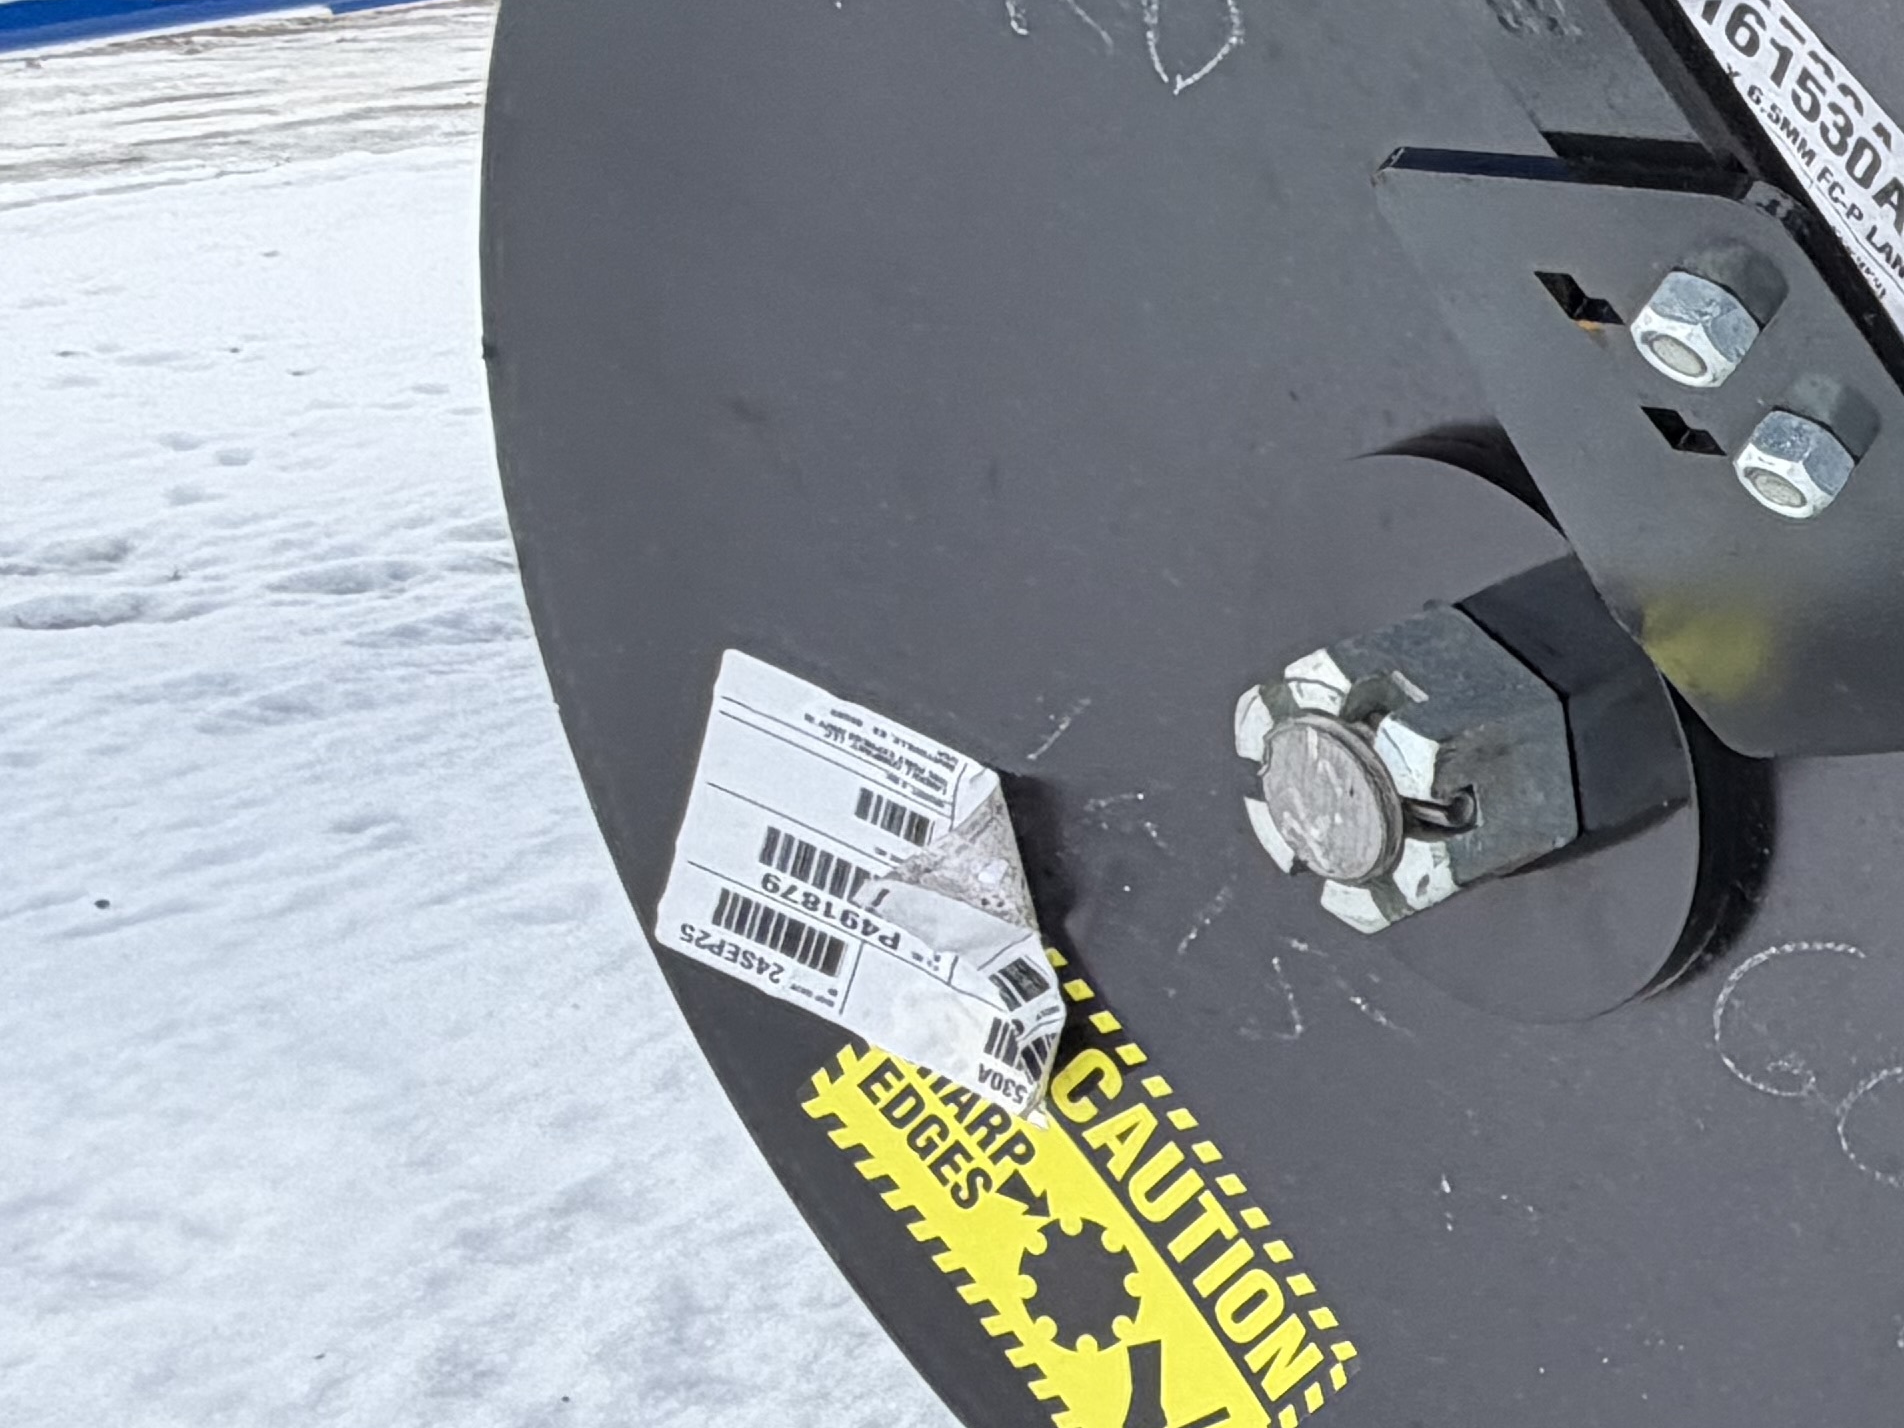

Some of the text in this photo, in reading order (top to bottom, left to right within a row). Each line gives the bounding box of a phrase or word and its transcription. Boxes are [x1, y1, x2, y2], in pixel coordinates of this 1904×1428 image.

[1816, 166, 1865, 224] FC-P
[761, 872, 902, 951] P491879
[679, 923, 786, 985] 24SEP25
[856, 1057, 994, 1211] EDGES
[1052, 1046, 1323, 1405] CAUTION
